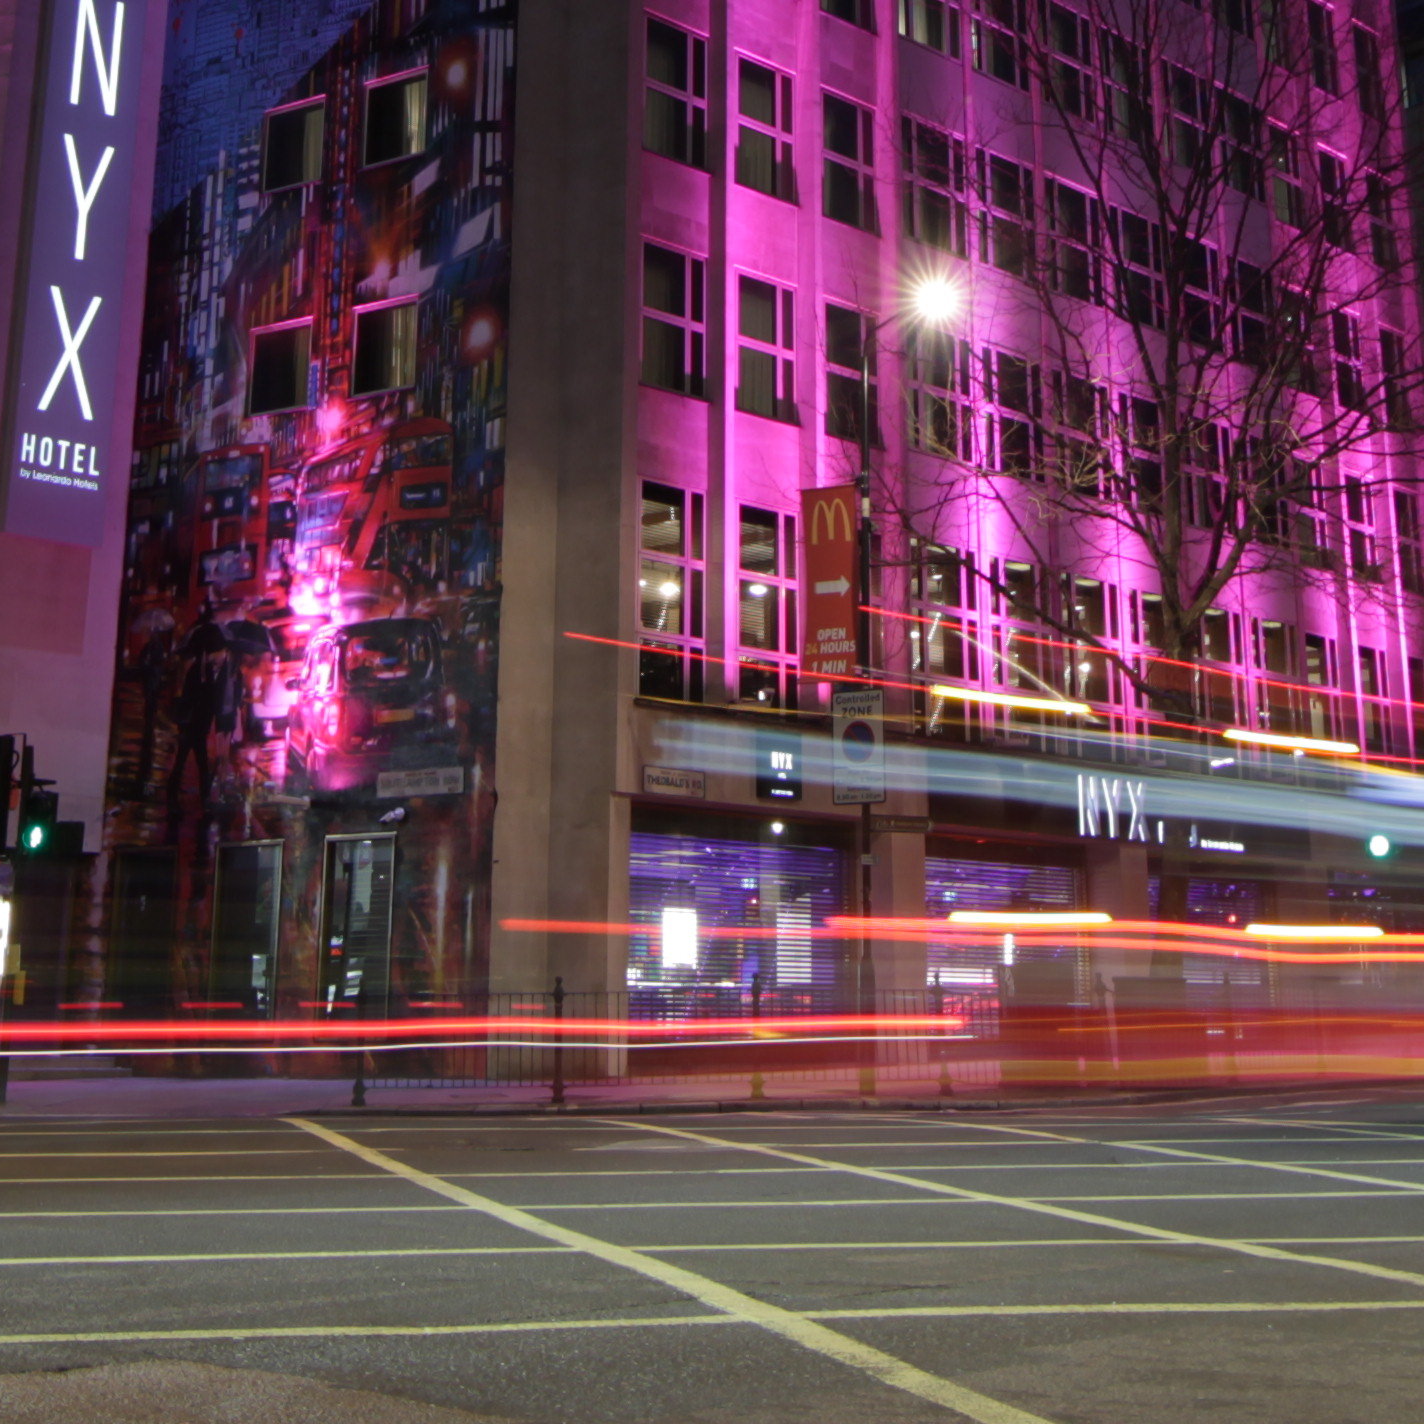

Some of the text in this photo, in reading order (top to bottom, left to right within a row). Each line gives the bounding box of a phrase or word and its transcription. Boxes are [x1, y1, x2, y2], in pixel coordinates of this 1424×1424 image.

[20, 432, 100, 477] HOTEL
[19, 467, 99, 491] by Leonardo Hotels
[816, 627, 847, 642] OPEN
[819, 639, 856, 654] HOURS
[821, 659, 847, 674] MIN
[835, 692, 881, 705] Controlled
[841, 705, 873, 719] ZONE
[1078, 774, 1151, 842] NYX
